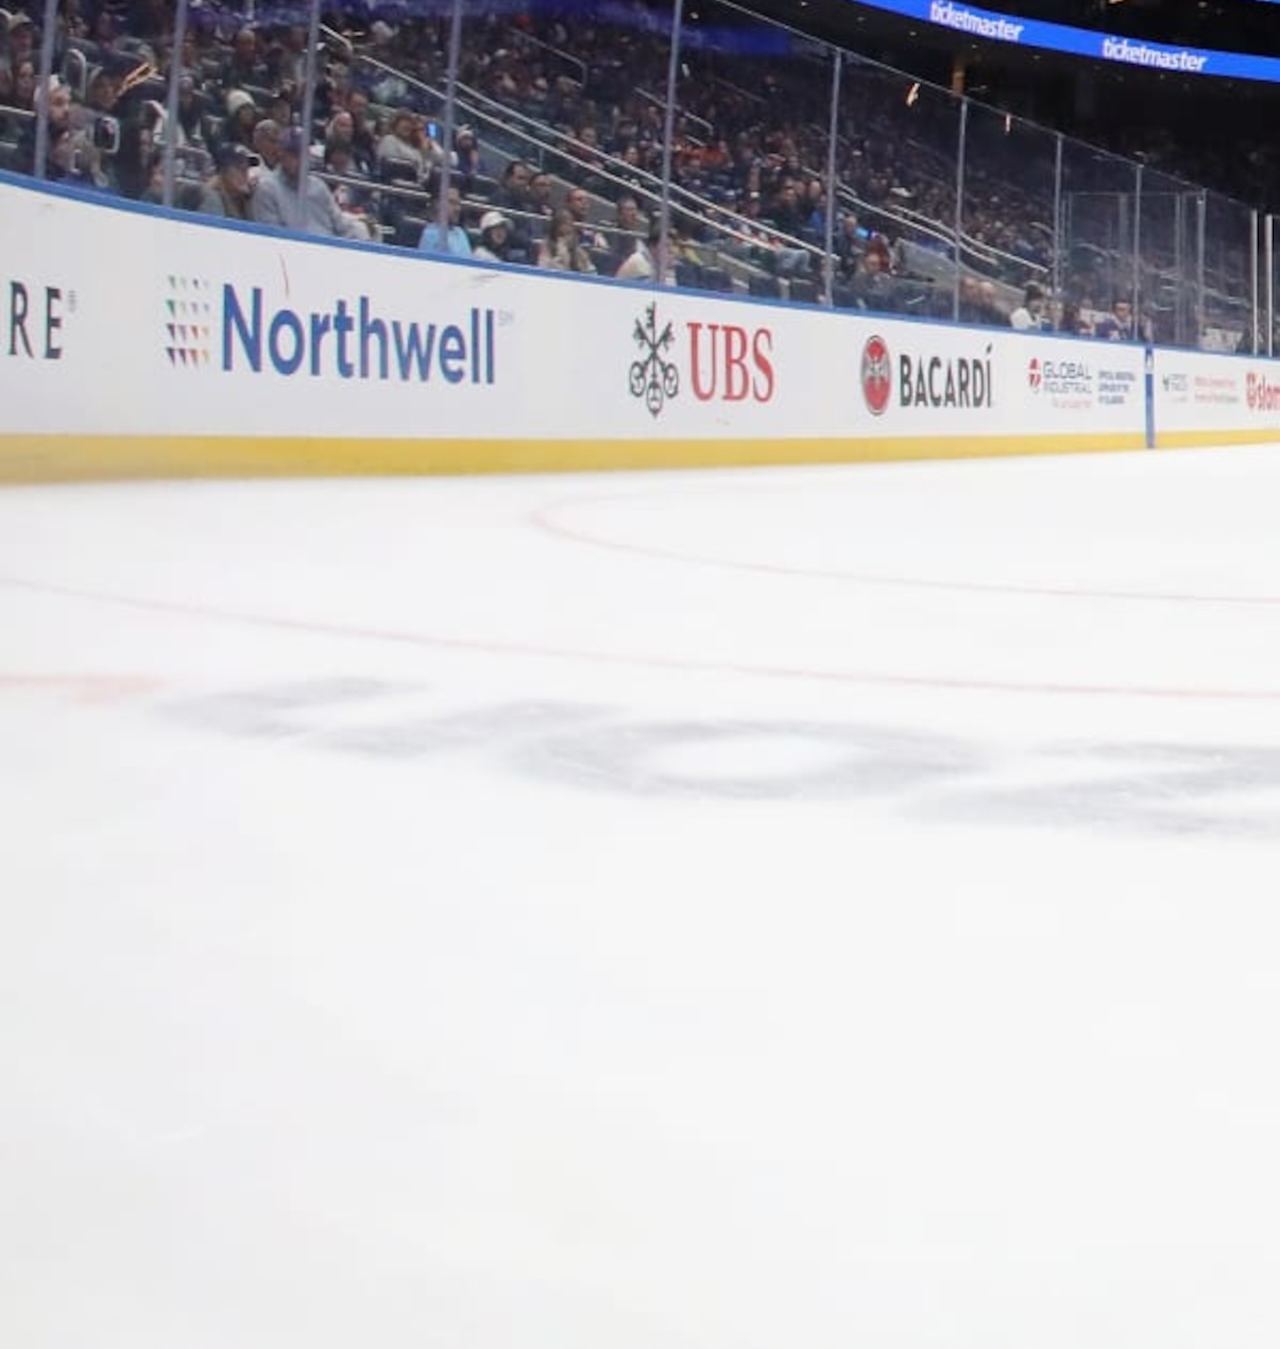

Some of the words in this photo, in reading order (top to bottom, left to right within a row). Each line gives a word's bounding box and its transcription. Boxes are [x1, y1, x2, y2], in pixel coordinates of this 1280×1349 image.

[1102, 36, 1207, 73] ticketmaster
[222, 284, 496, 385] Northwell
[686, 321, 775, 404] UBS
[898, 343, 994, 410] BACARDÍ
[1043, 360, 1093, 379] GLOBAL
